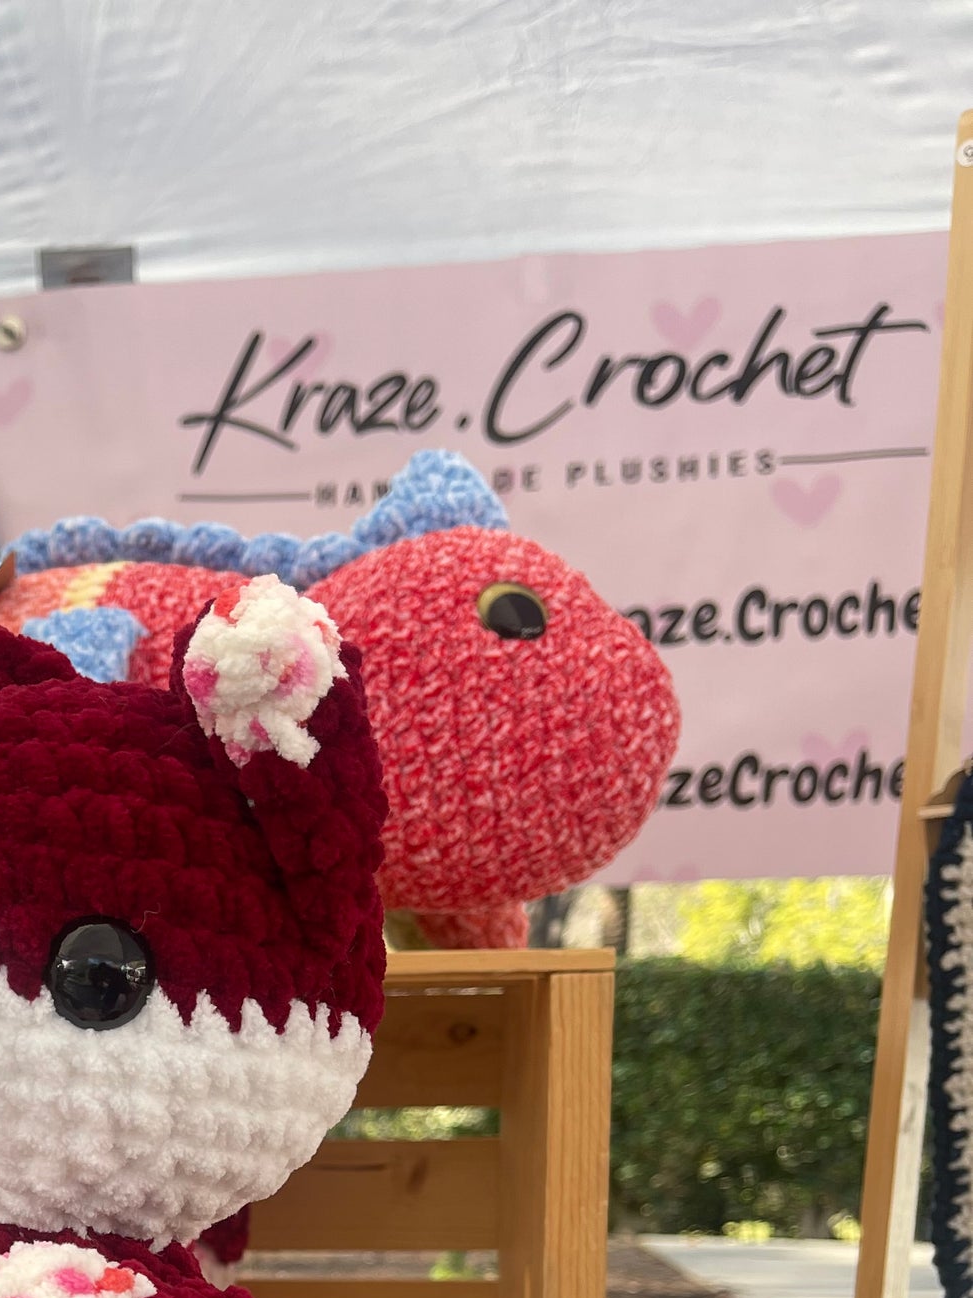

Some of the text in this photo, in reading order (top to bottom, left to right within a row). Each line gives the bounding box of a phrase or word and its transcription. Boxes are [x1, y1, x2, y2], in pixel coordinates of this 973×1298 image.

[179, 304, 932, 476] Kraze.Crochet
[315, 448, 775, 506] HANDE PLUSHIES
